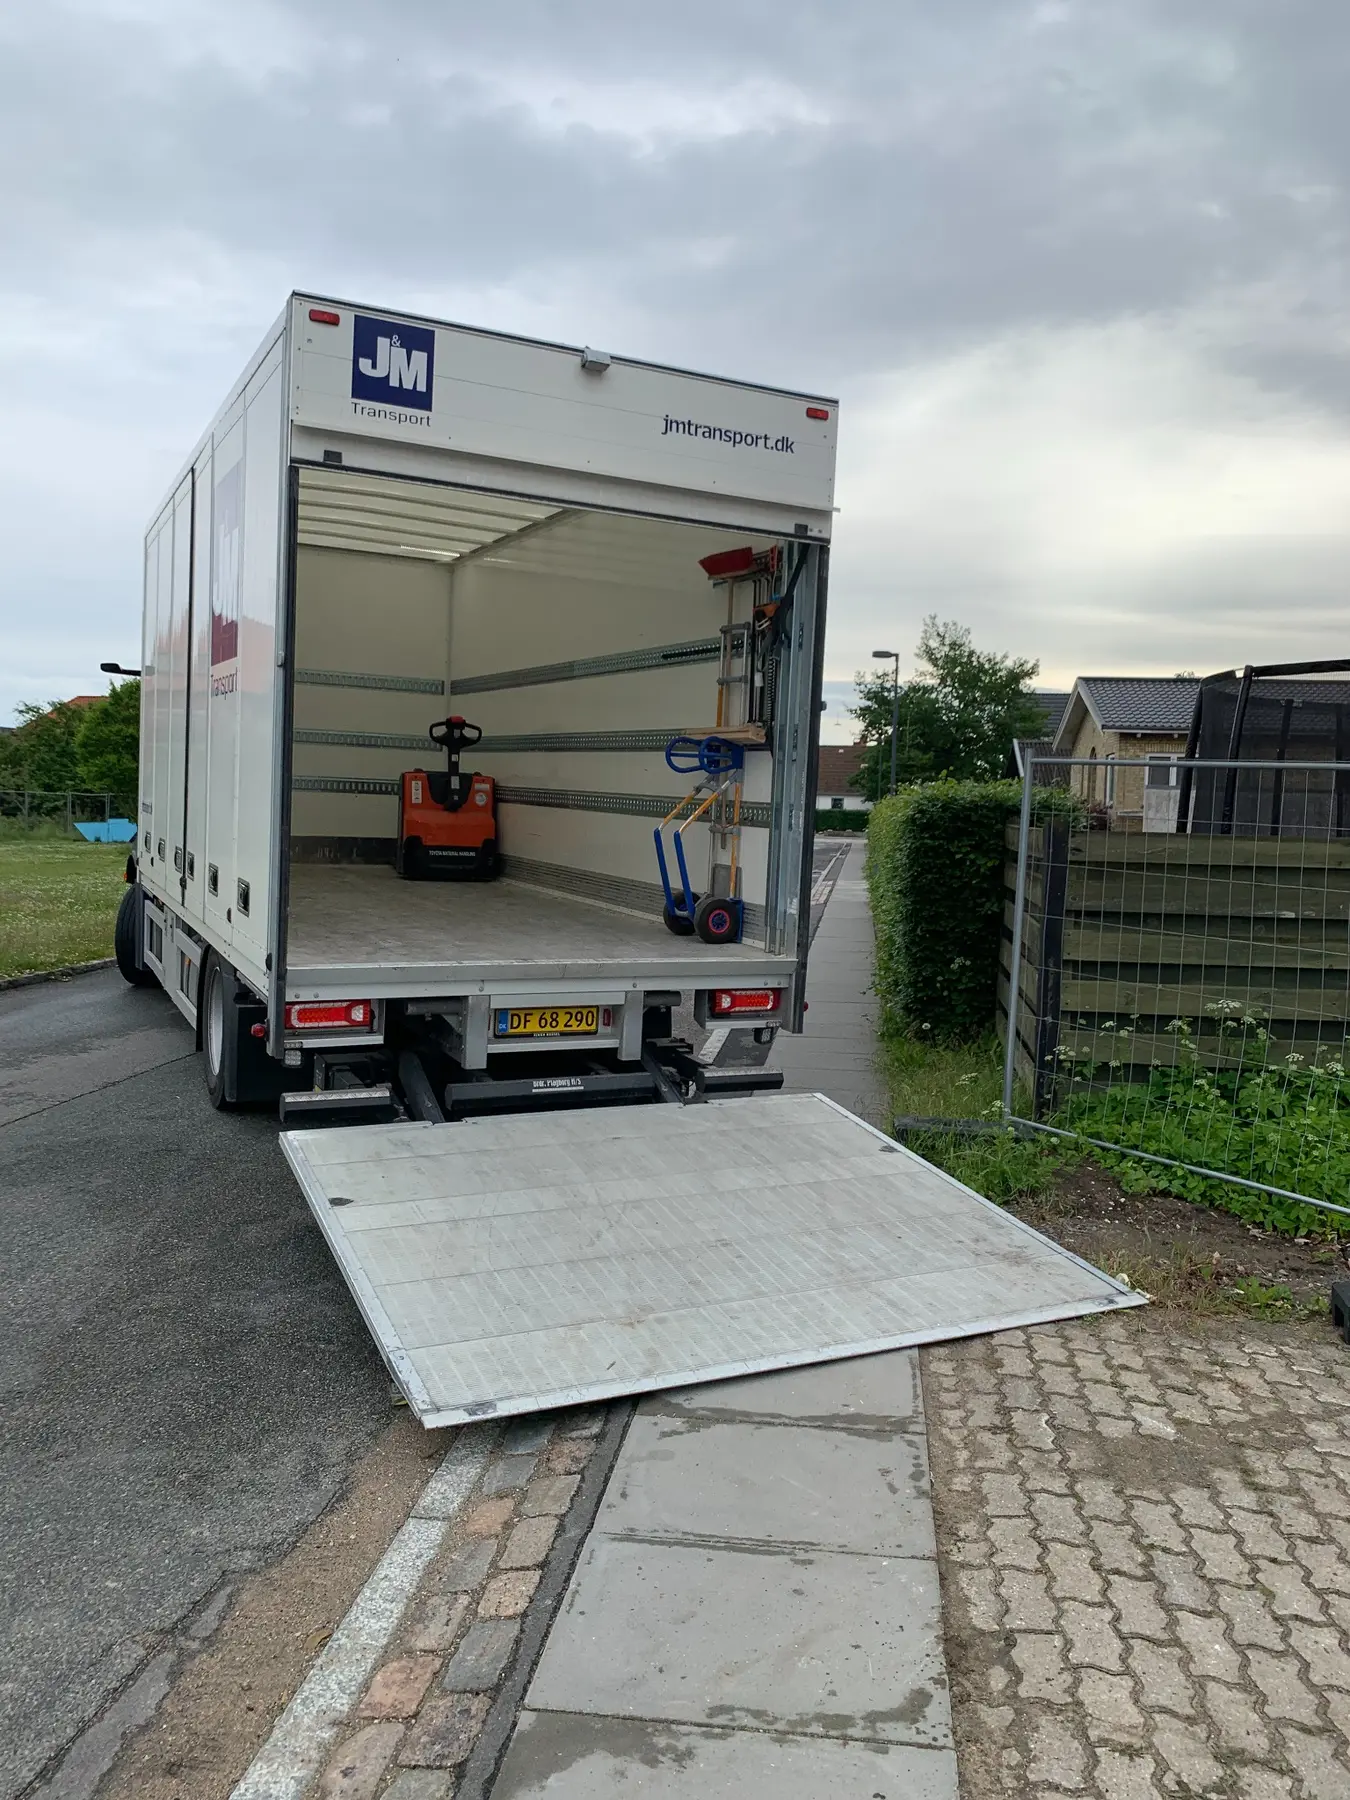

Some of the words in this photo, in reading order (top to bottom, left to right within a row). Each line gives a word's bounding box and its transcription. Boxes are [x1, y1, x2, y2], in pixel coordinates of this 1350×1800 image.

[351, 402, 431, 427] Transport
[661, 415, 795, 454] jmtransport.dk
[510, 1013, 533, 1030] DF
[538, 1011, 559, 1029] 68
[563, 1010, 595, 1028] 290
